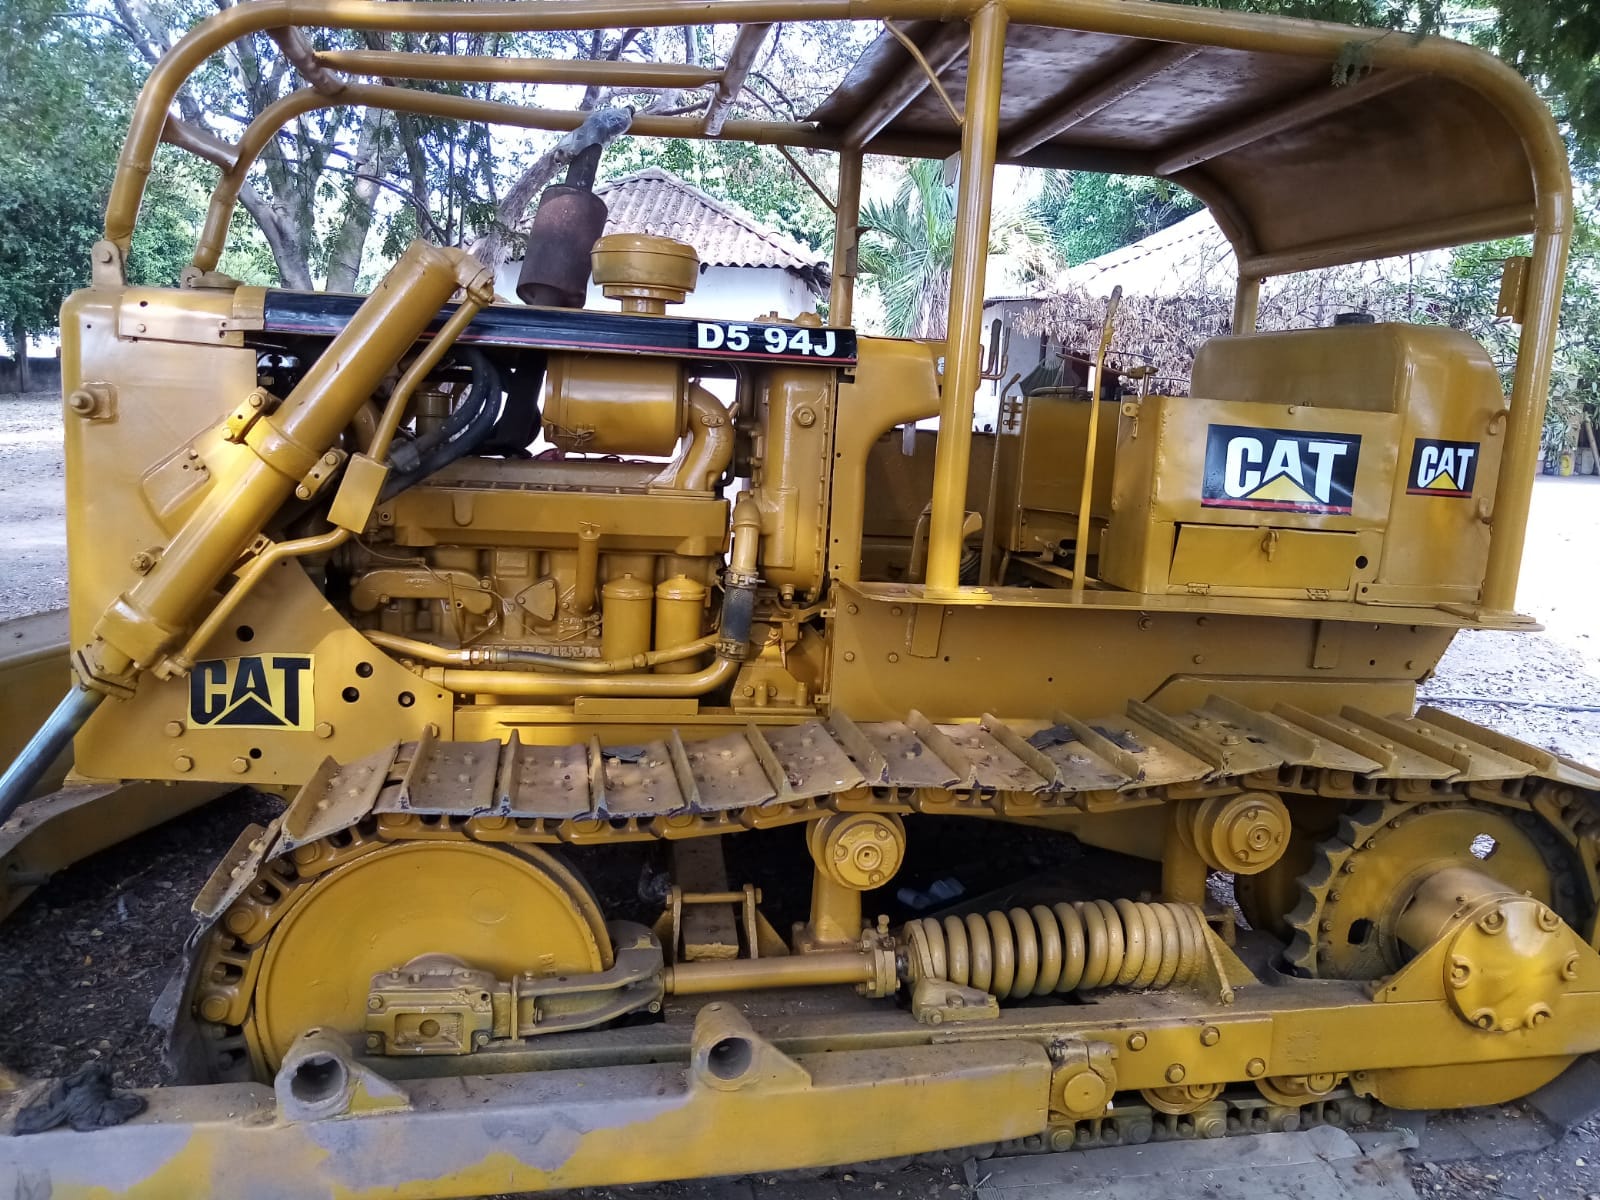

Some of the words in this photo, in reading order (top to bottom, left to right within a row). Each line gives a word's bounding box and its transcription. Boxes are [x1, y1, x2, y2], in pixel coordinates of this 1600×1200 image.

[698, 322, 750, 351] D5
[763, 327, 837, 357] 94J
[1223, 436, 1349, 504] CAT
[1416, 445, 1475, 491] CAT
[190, 656, 311, 727] CAT
